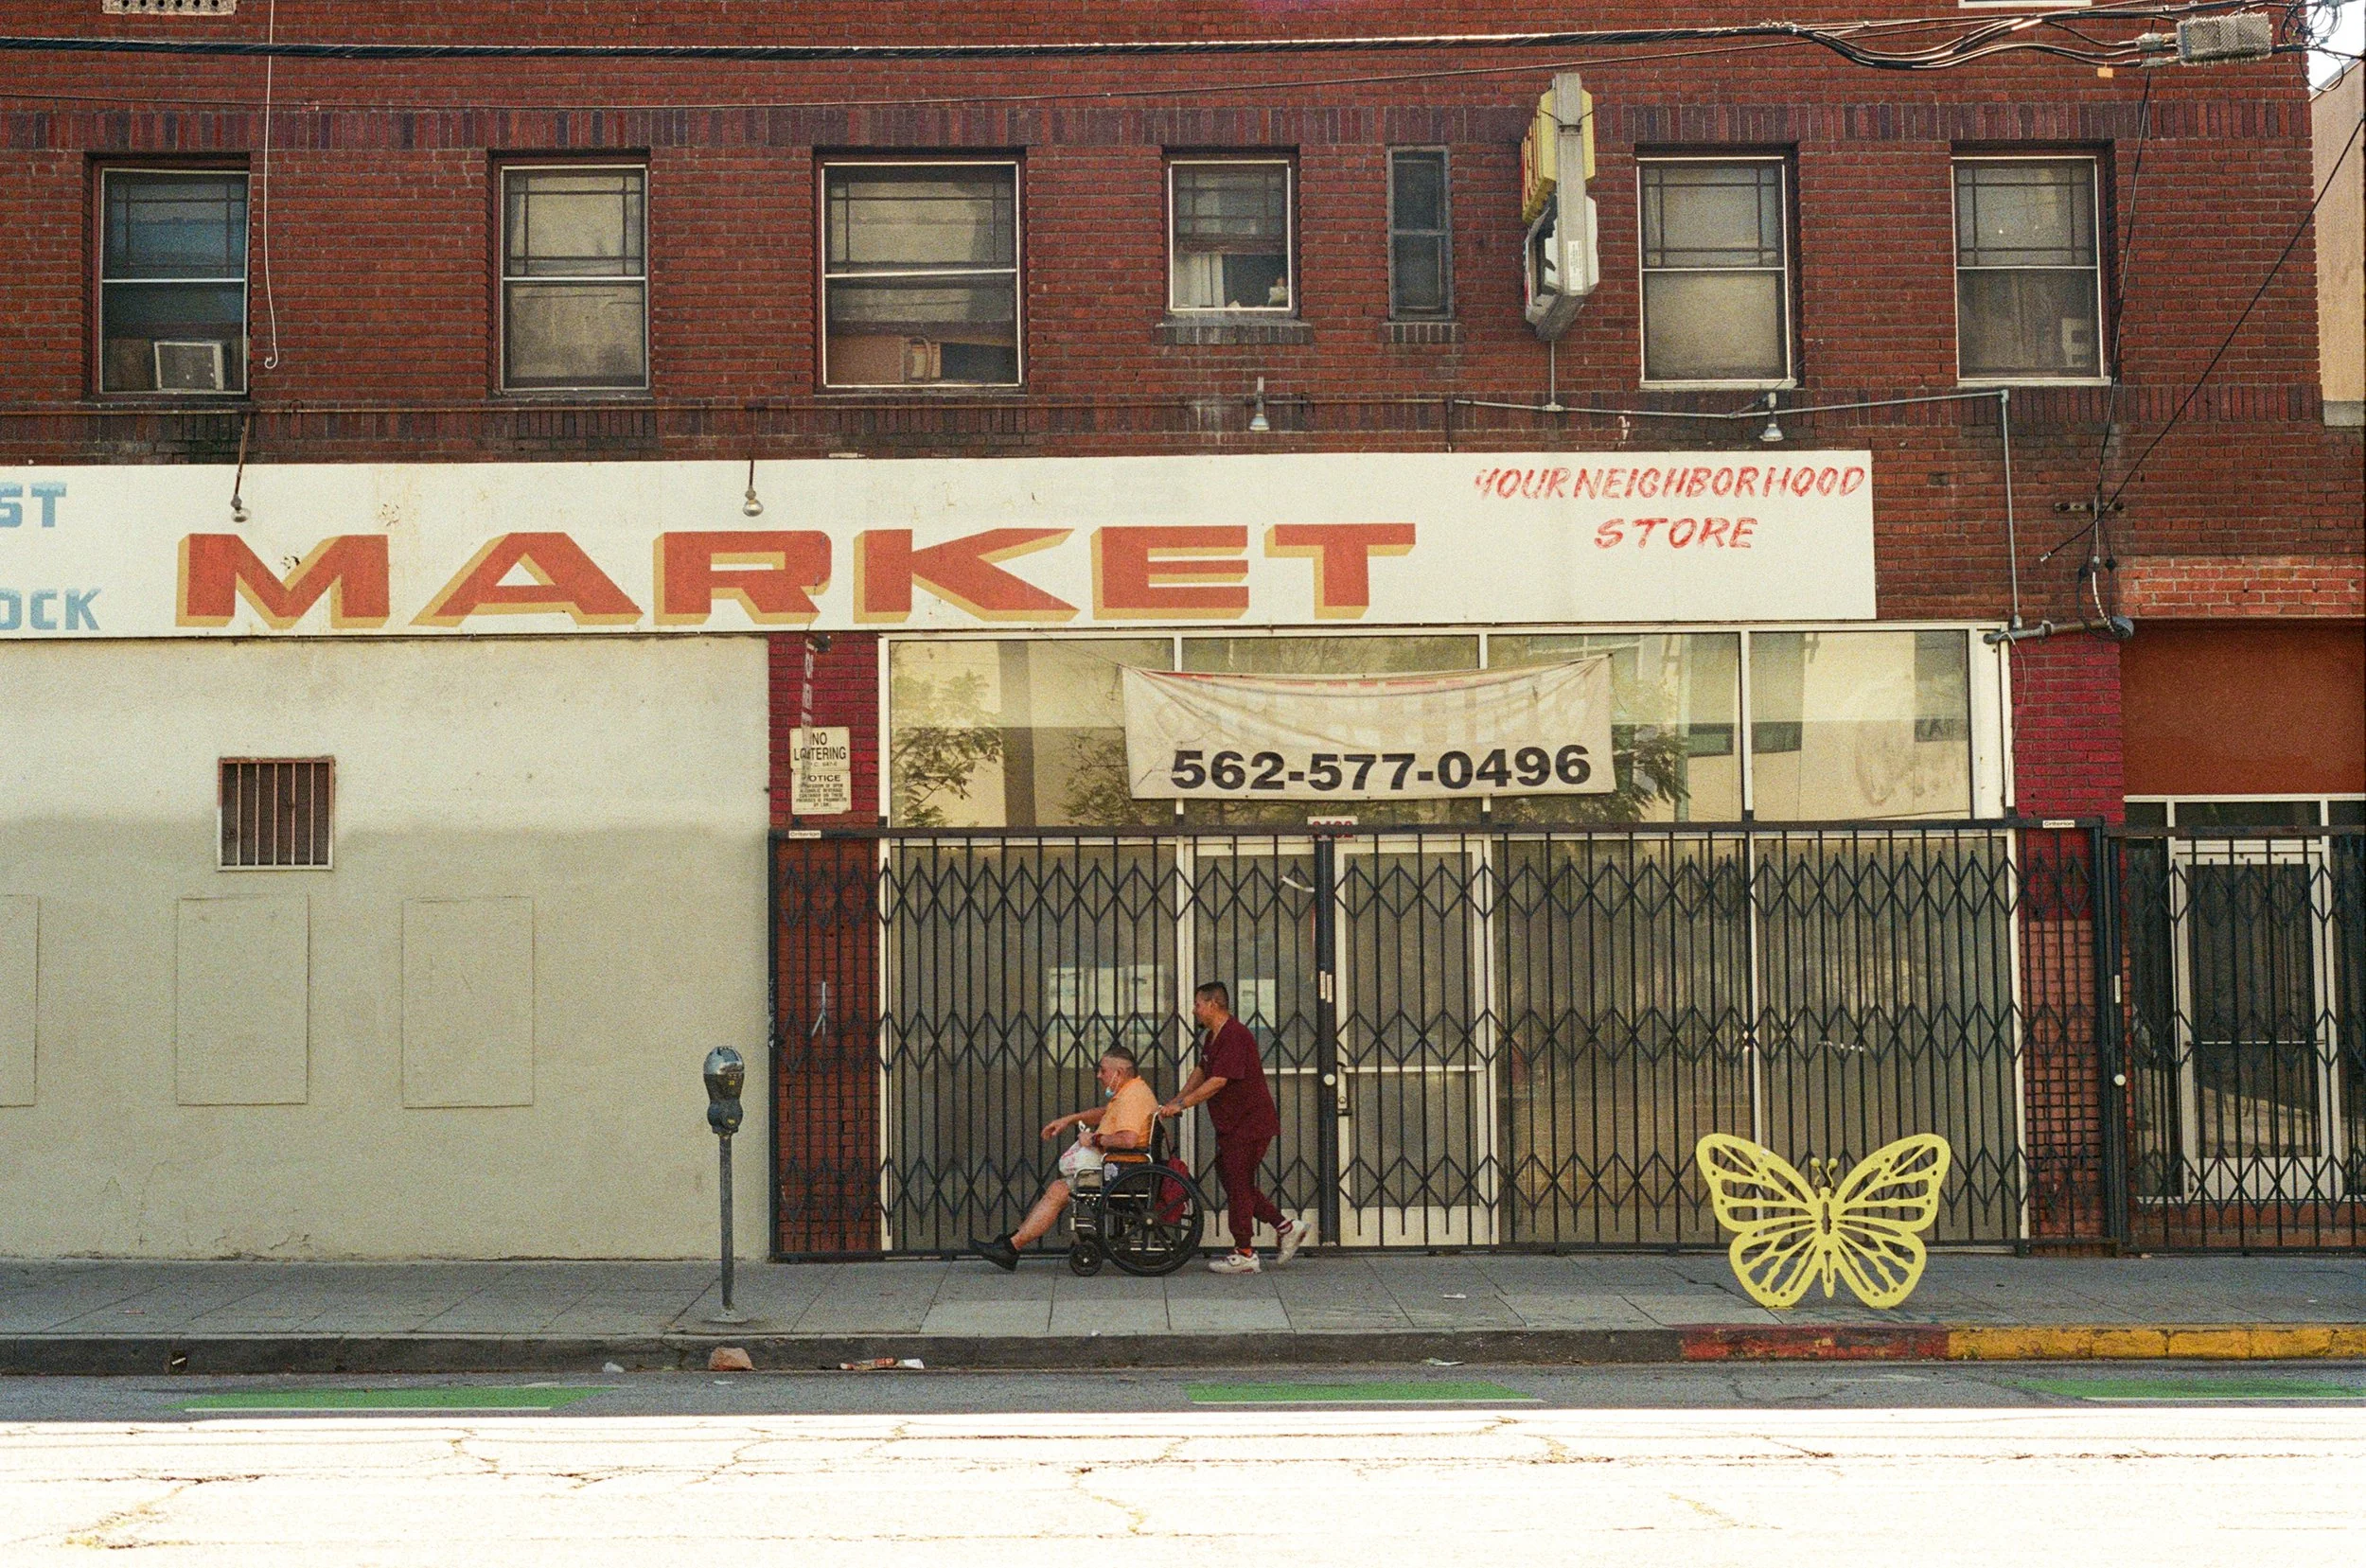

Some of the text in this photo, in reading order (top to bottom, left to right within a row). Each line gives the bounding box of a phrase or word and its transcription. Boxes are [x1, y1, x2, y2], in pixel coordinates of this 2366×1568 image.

[1474, 467, 1572, 501] YOUR
[1594, 517, 1758, 550] STORE
[175, 522, 1416, 629] MARKET
[812, 731, 828, 746] NO
[1171, 744, 1592, 791] 562-577-0496
